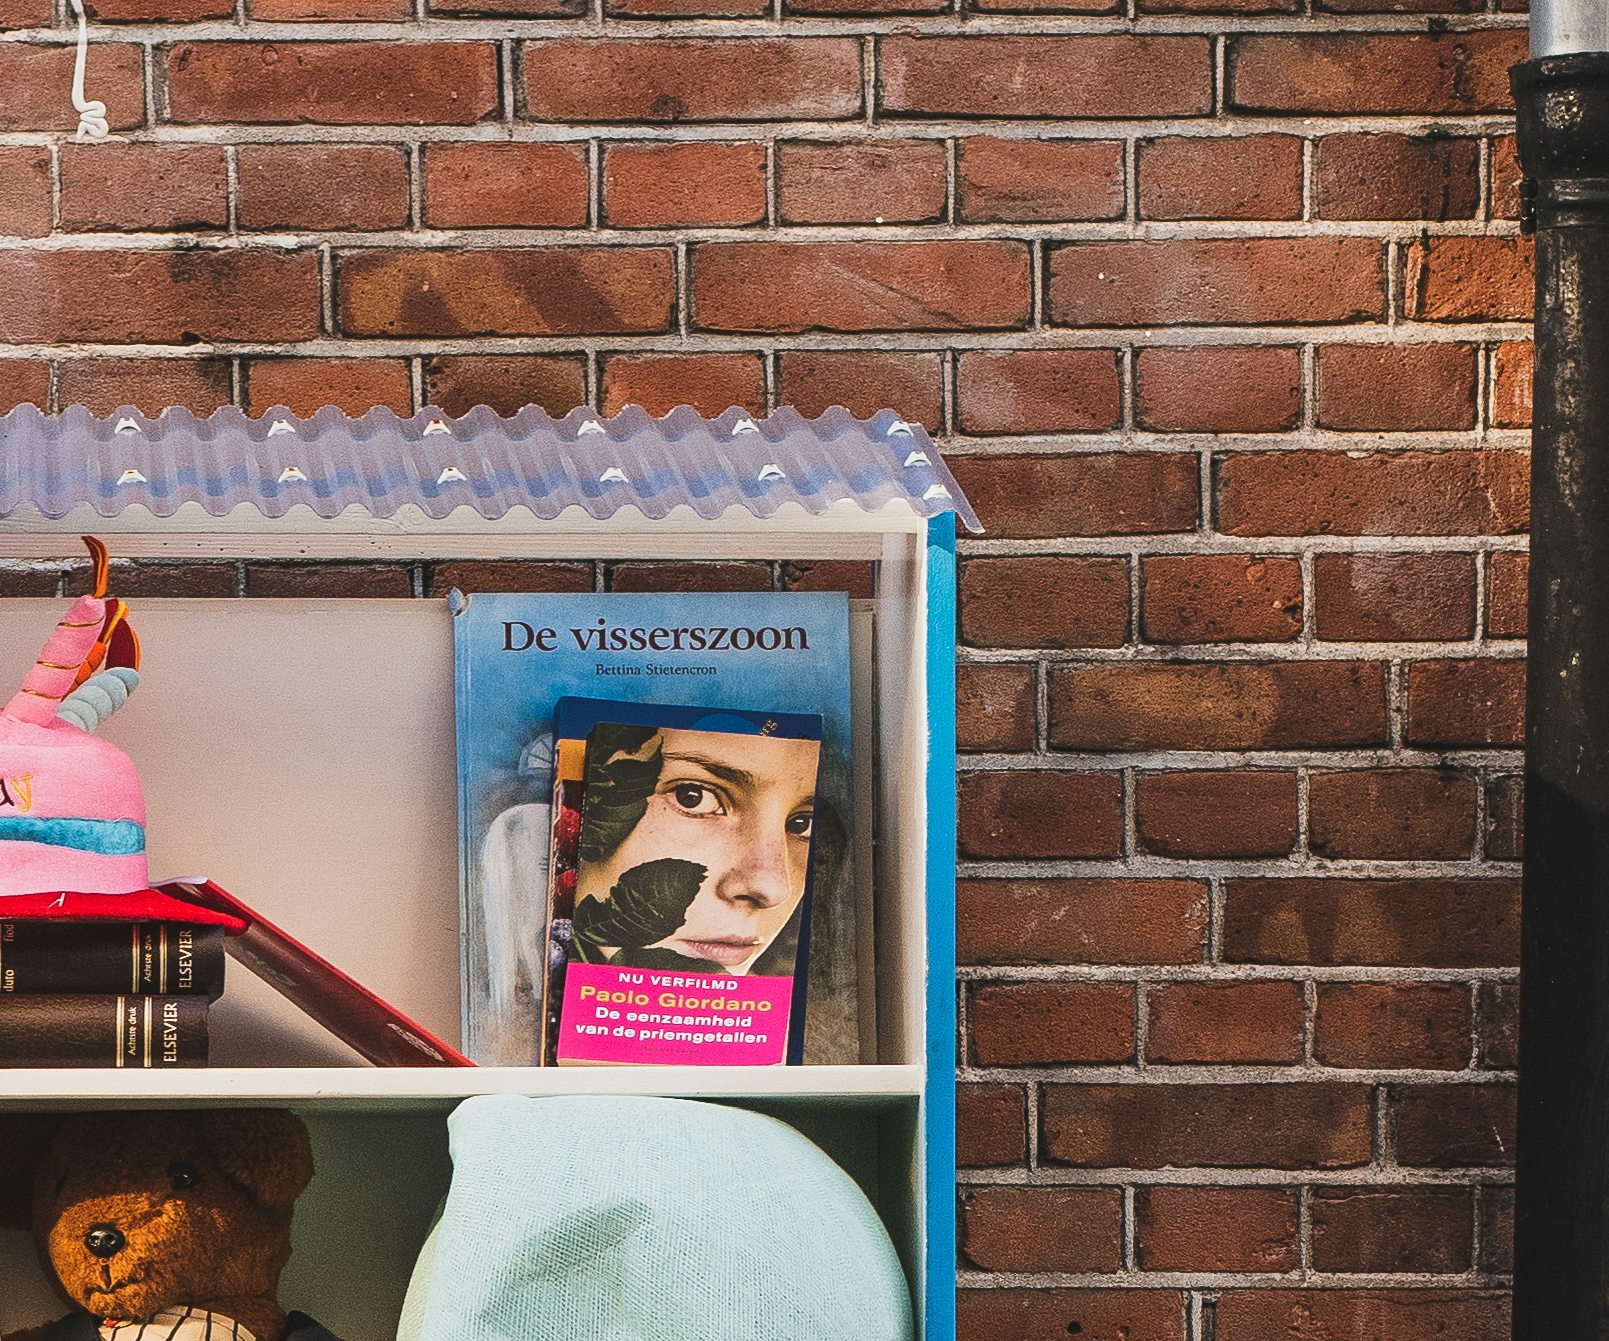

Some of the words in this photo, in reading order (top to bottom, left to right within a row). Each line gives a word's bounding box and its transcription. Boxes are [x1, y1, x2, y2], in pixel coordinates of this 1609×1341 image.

[501, 621, 557, 651] De
[570, 618, 810, 651] visserszoon
[596, 663, 640, 675] Bettina
[646, 663, 717, 676] Stietencron
[179, 930, 192, 988] ELSEVIER
[619, 973, 643, 984] NU
[650, 975, 738, 990] VERFILMD
[580, 986, 649, 1006] Paolo
[658, 992, 772, 1012] Giordano
[595, 1007, 620, 1020] De
[626, 1011, 751, 1027] eenzaamheid
[163, 1002, 178, 1062] ELSEVIER
[575, 1025, 608, 1036] van
[613, 1025, 635, 1038] de
[639, 1029, 767, 1044] priemgetallen
